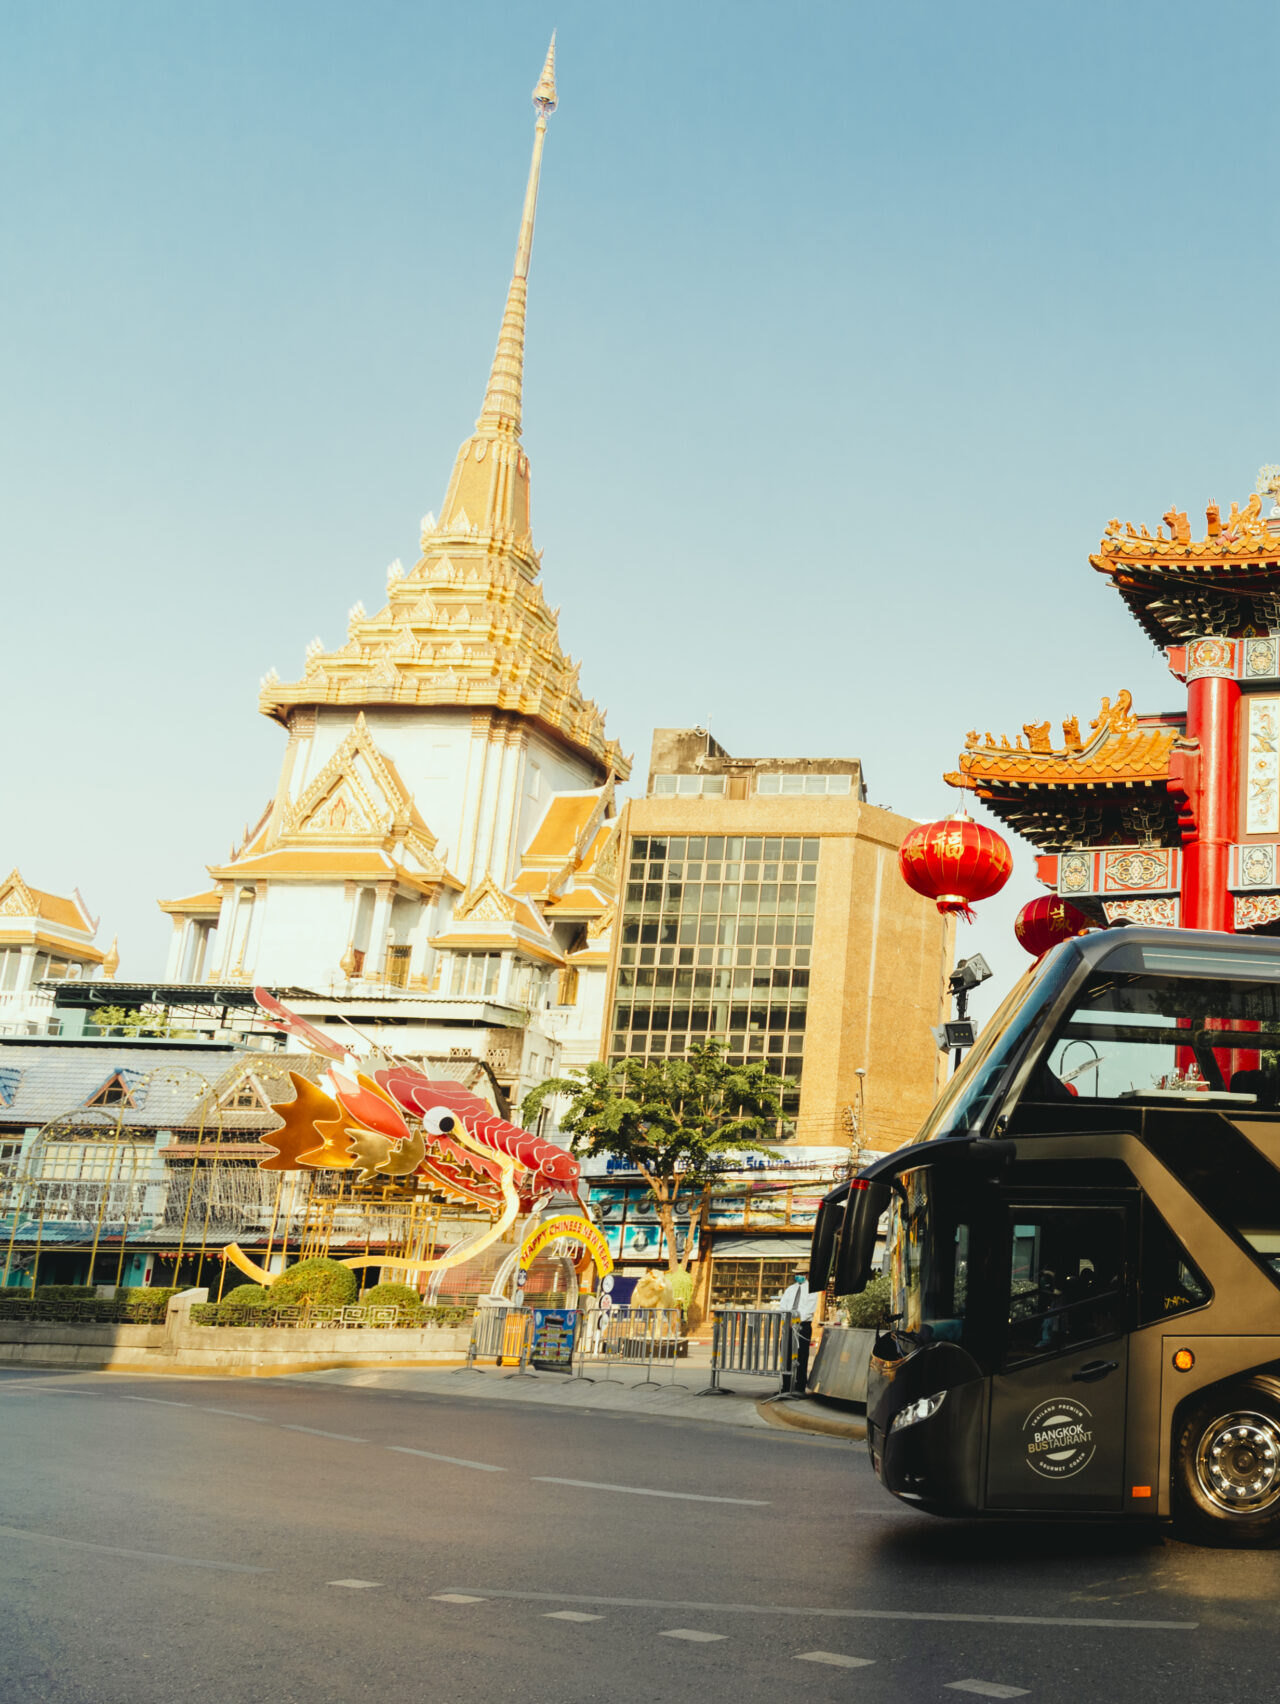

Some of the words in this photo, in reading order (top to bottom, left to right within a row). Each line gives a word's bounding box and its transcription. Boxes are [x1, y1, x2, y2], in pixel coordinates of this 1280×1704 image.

[520, 1229, 547, 1263] HAPPY
[548, 1220, 582, 1236] CHINESE
[582, 1225, 599, 1243] NEW
[596, 1242, 610, 1272] YEAR
[1027, 1430, 1093, 1454] BUSTAURANT
[1034, 1423, 1084, 1443] BANGKOK
